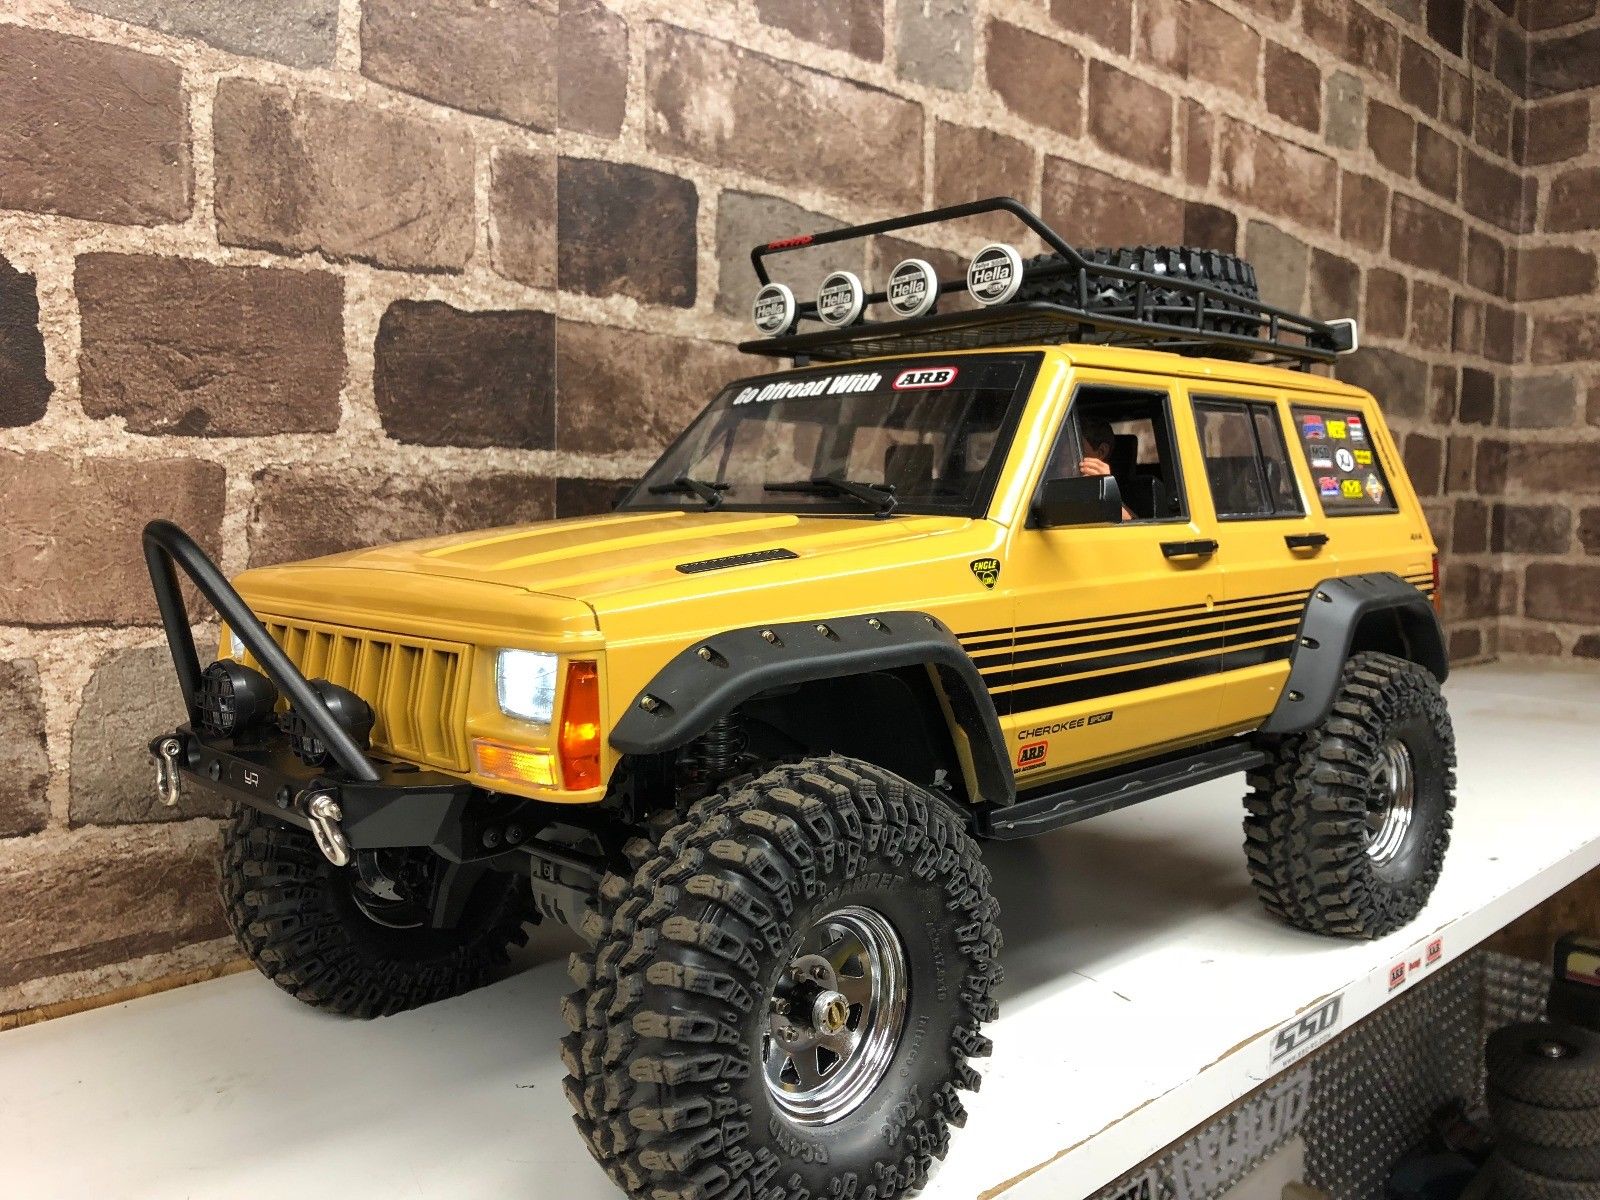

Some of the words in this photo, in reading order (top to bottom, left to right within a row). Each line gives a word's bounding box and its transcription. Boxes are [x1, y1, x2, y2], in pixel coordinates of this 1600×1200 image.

[974, 266, 1009, 284] Hella
[893, 280, 925, 298] Hella
[822, 292, 851, 308] Hella
[756, 303, 783, 319] Hella
[898, 371, 950, 386] ARB
[733, 387, 759, 405] Go
[756, 377, 832, 401] Offroad
[827, 373, 882, 394] With
[973, 560, 997, 571] ENGLE
[1018, 718, 1085, 739] CHEROKEE
[1090, 713, 1111, 724] SPORT
[1021, 745, 1045, 762] ARB
[1273, 996, 1341, 1061] SSD
